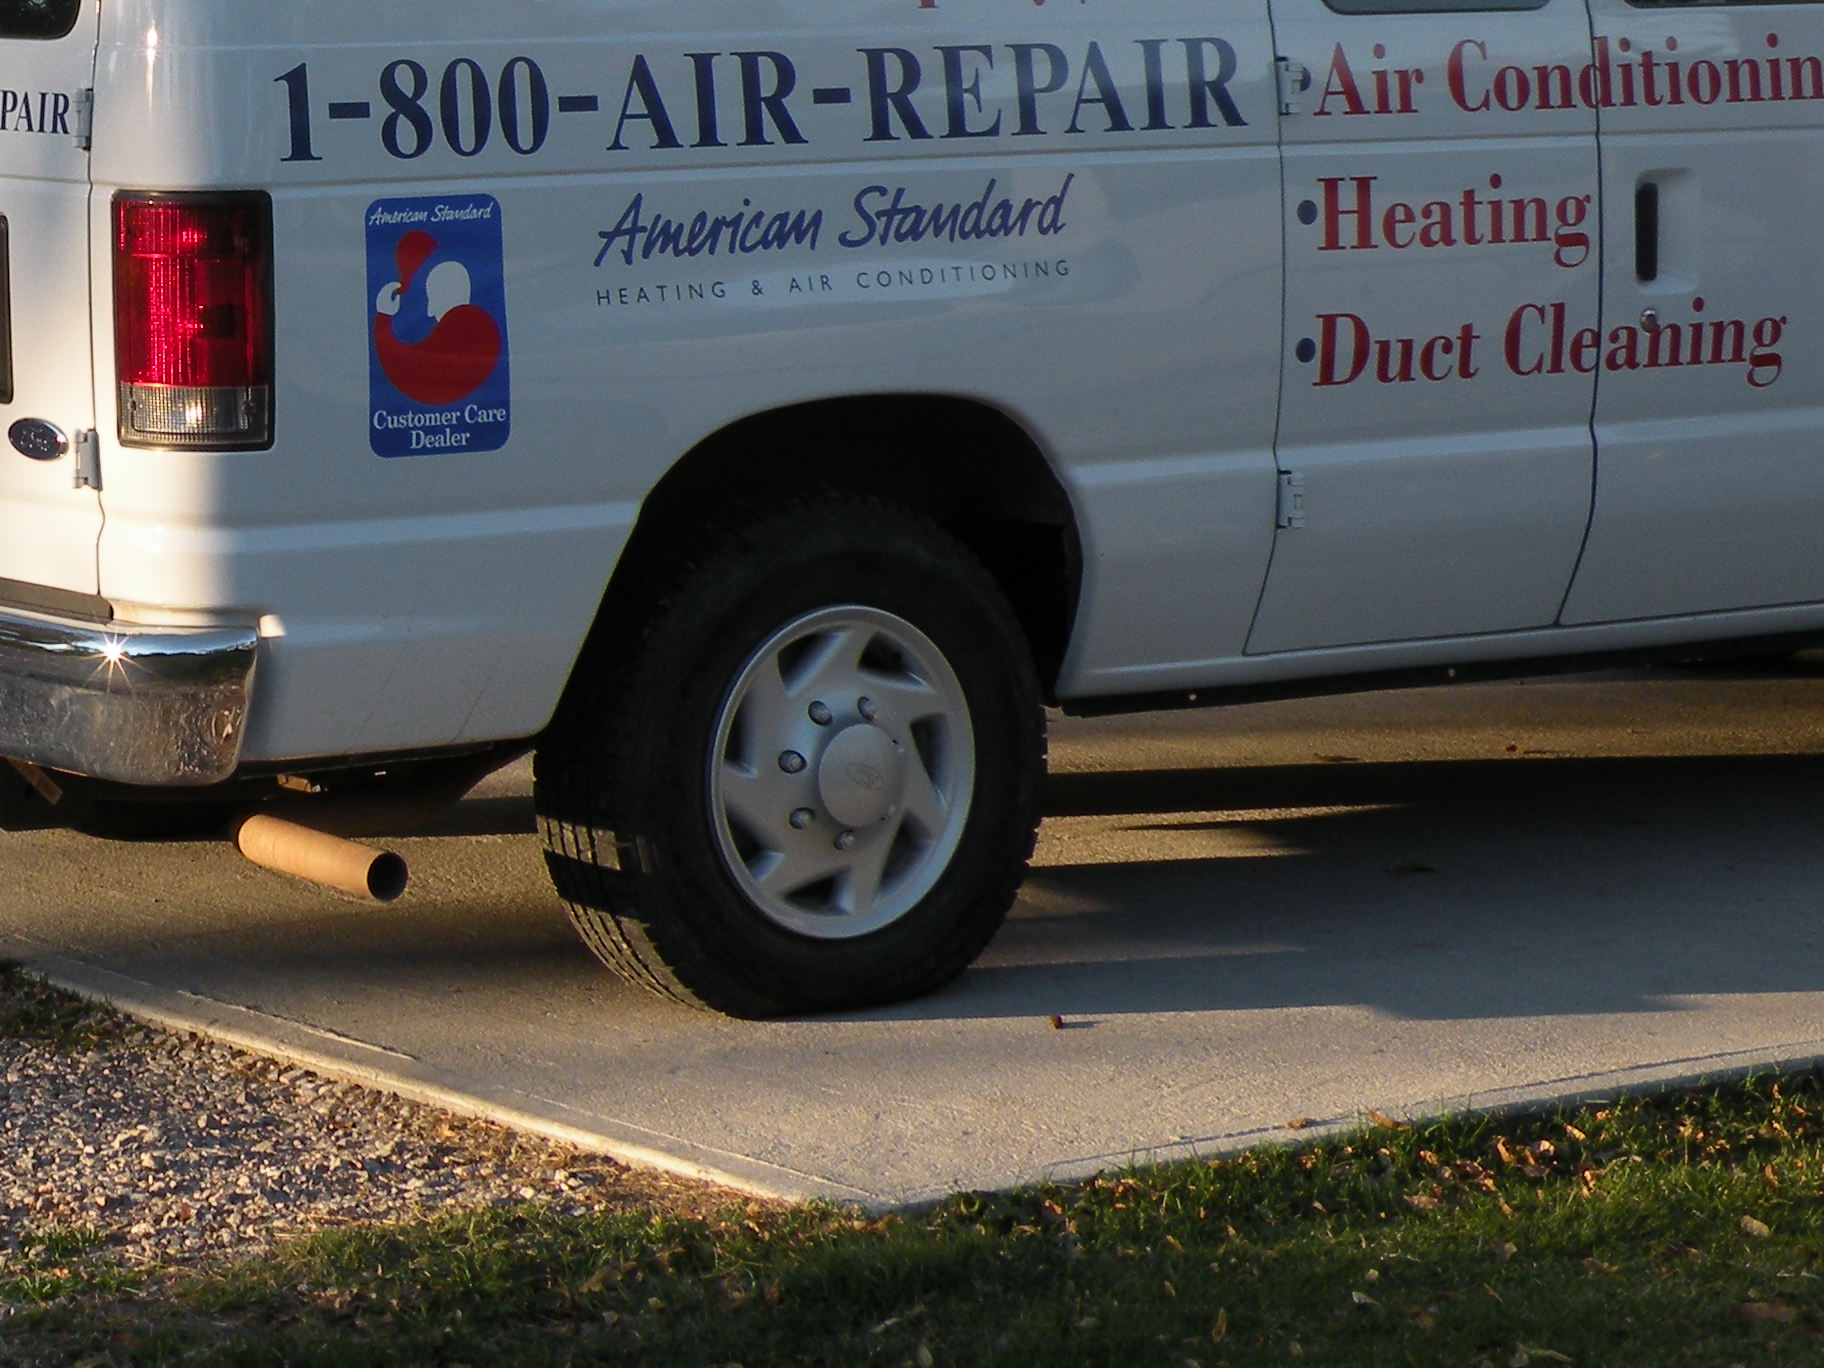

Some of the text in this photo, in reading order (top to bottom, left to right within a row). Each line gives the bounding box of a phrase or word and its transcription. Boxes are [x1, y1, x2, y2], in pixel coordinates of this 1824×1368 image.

[273, 35, 1249, 163] 1-800-AIR-REPAIR
[1313, 32, 1824, 116] Air Conditionin
[369, 202, 494, 226] American Standard
[593, 173, 1074, 268] American Standard
[1316, 173, 1592, 268] Heating
[596, 259, 1071, 306] HEATING & AIR CONDITIONING
[1312, 297, 1789, 388] Duct Cleaning
[373, 404, 506, 430] Customer Care
[410, 429, 470, 449] Dealer
